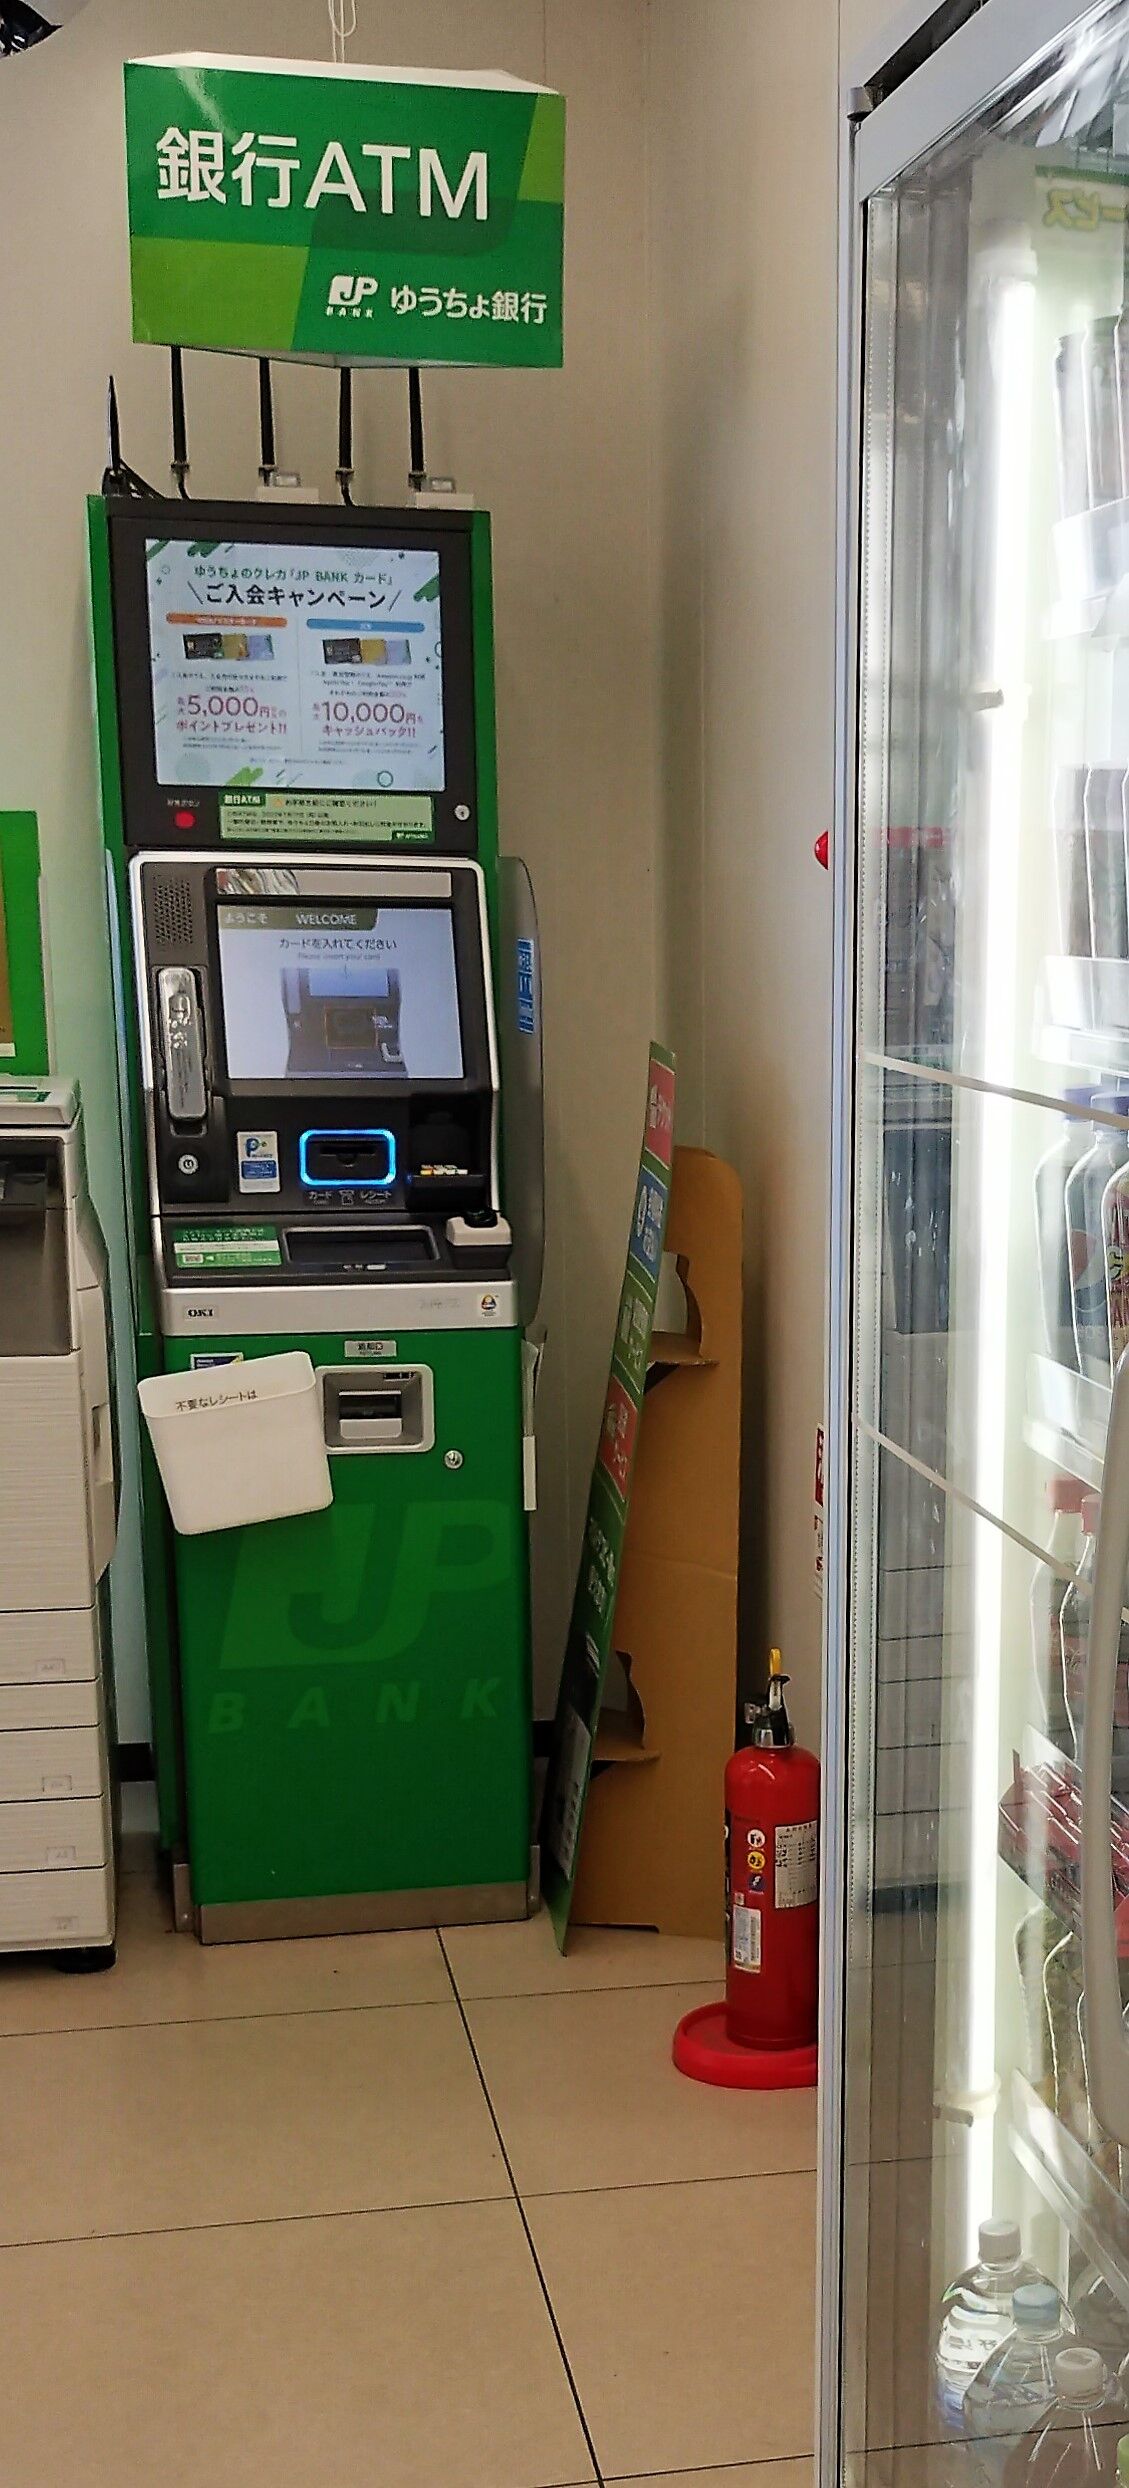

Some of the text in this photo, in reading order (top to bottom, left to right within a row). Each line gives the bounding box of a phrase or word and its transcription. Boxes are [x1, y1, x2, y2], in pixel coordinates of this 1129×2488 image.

[156, 126, 488, 221] 銀行ATM
[329, 275, 378, 306] JP
[326, 306, 374, 319] BANK
[391, 285, 548, 324] ゆうちょ銀行
[315, 570, 348, 582] BANK
[207, 583, 385, 609] ご入会キャンペーン
[224, 912, 268, 924] ようこそ
[296, 913, 357, 925] WELCOME
[280, 938, 397, 950] カードを入れてください
[187, 1309, 213, 1317] OKI
[175, 1389, 258, 1411] 不要なレシートは
[208, 1678, 500, 1734] BANK
